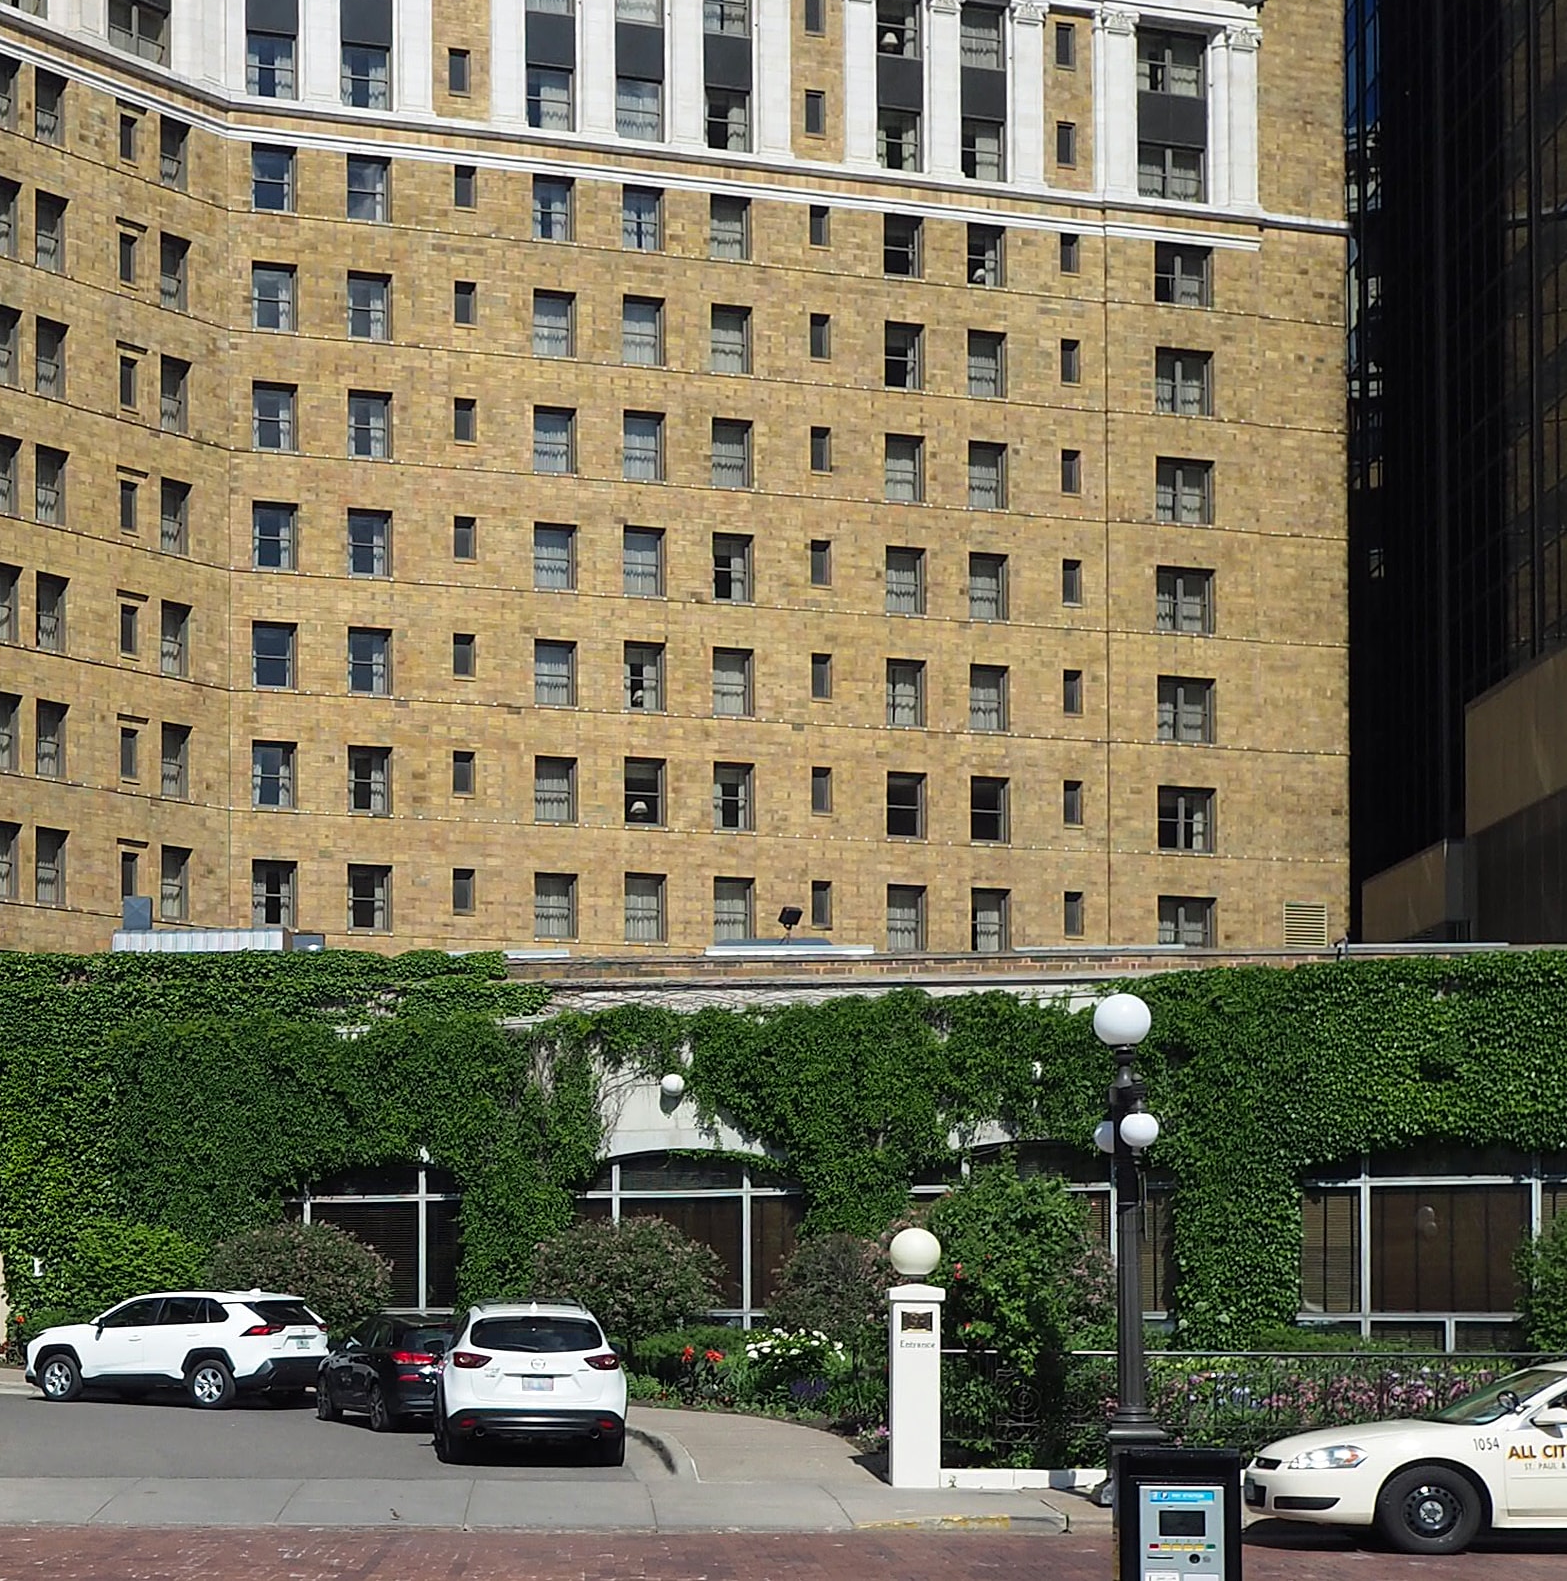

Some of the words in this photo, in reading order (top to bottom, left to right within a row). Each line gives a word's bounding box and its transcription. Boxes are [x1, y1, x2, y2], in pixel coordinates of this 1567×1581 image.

[900, 1339, 936, 1349] Entrance
[1473, 1437, 1500, 1451] 1054
[1507, 1445, 1537, 1459] ALL
[1538, 1462, 1557, 1470] PAUL
